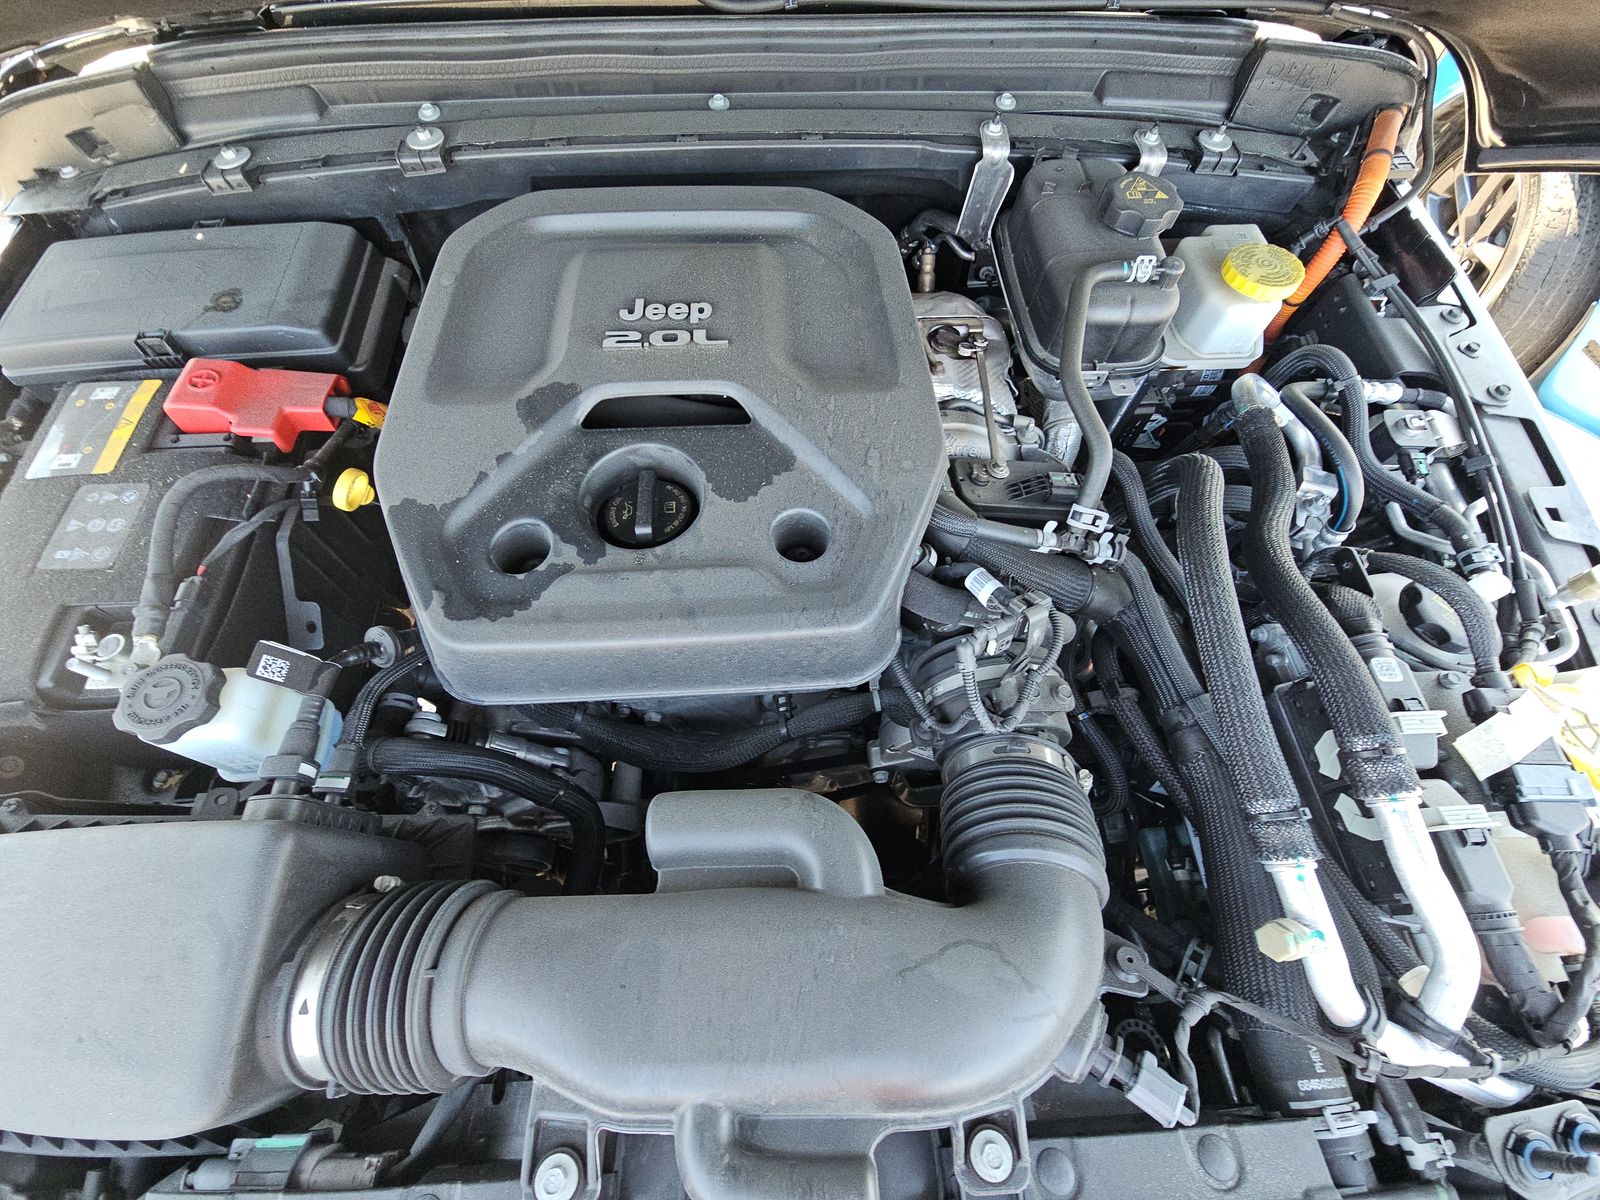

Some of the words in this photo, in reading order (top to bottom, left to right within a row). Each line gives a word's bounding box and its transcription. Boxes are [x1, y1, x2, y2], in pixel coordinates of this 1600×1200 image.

[619, 298, 713, 324] Jeep
[602, 329, 729, 349] 2.0L
[1307, 1044, 1327, 1073] PHEV
